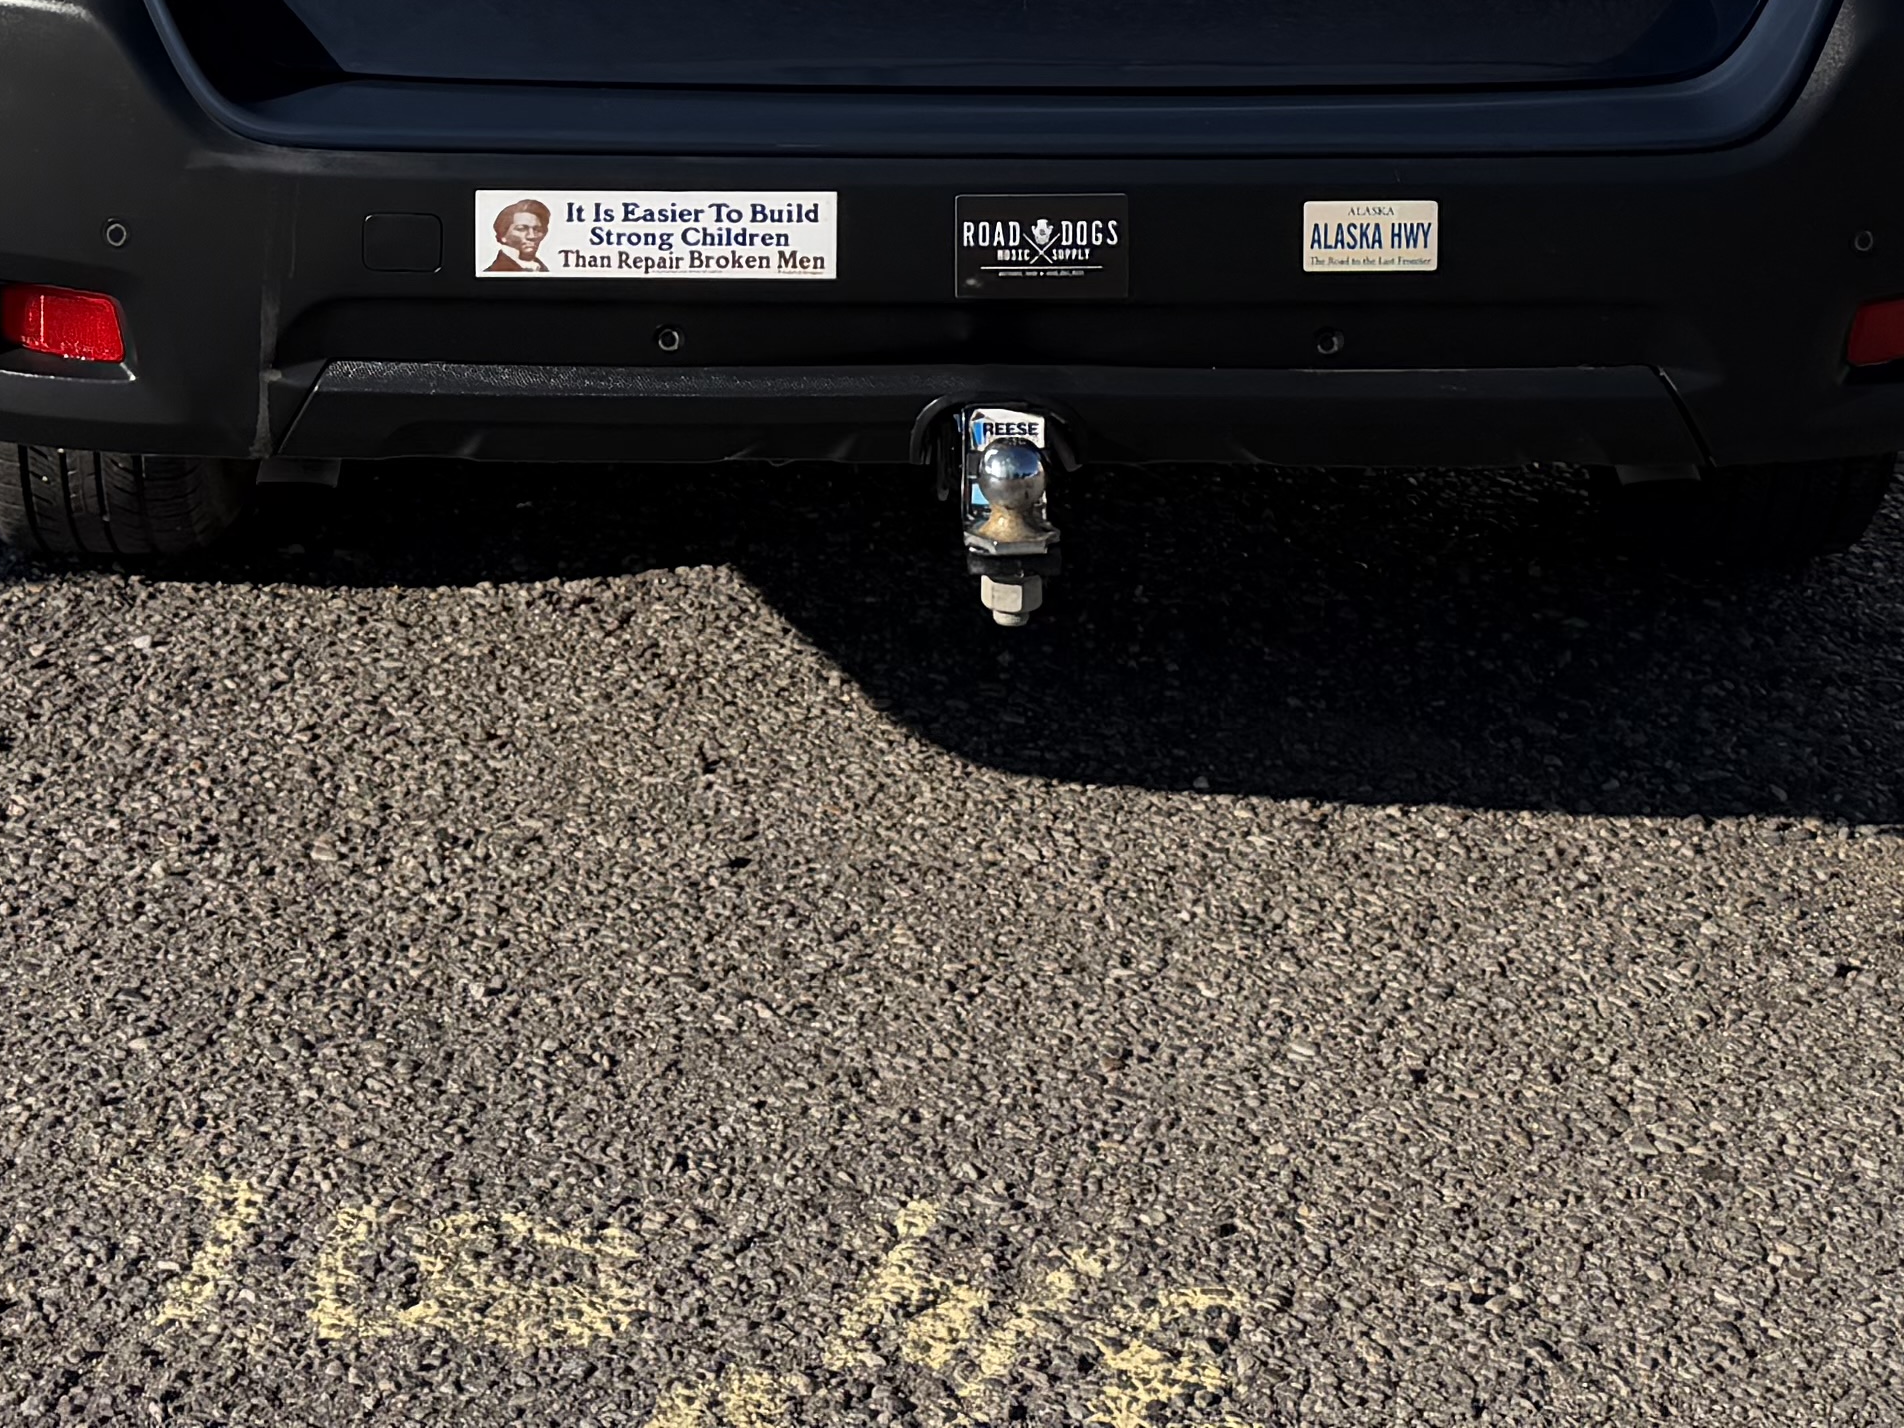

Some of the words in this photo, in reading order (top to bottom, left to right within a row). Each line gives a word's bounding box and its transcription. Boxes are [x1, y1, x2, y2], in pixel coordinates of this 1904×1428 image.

[566, 202, 585, 223] It
[594, 202, 615, 223] Is
[622, 202, 705, 223] Easier
[709, 202, 743, 224] To
[749, 203, 820, 224] Build
[1348, 206, 1395, 216] ALASKA
[589, 226, 674, 251] Strong
[681, 227, 790, 247] Children
[963, 221, 1021, 247] ROAD
[1061, 220, 1119, 246] DOGS
[1310, 222, 1383, 250] ALASKA
[1390, 222, 1433, 250] HWY
[558, 249, 612, 269] Than
[617, 250, 685, 274] Repair
[688, 250, 771, 269] Broken
[777, 251, 826, 270] Men
[997, 249, 1031, 261] MUSIC
[1052, 248, 1091, 261] SUPPLY
[1310, 256, 1325, 266] The
[1328, 256, 1350, 266] Road
[1363, 256, 1377, 266] the
[1378, 256, 1395, 266] Last
[983, 422, 1040, 436] REESE
